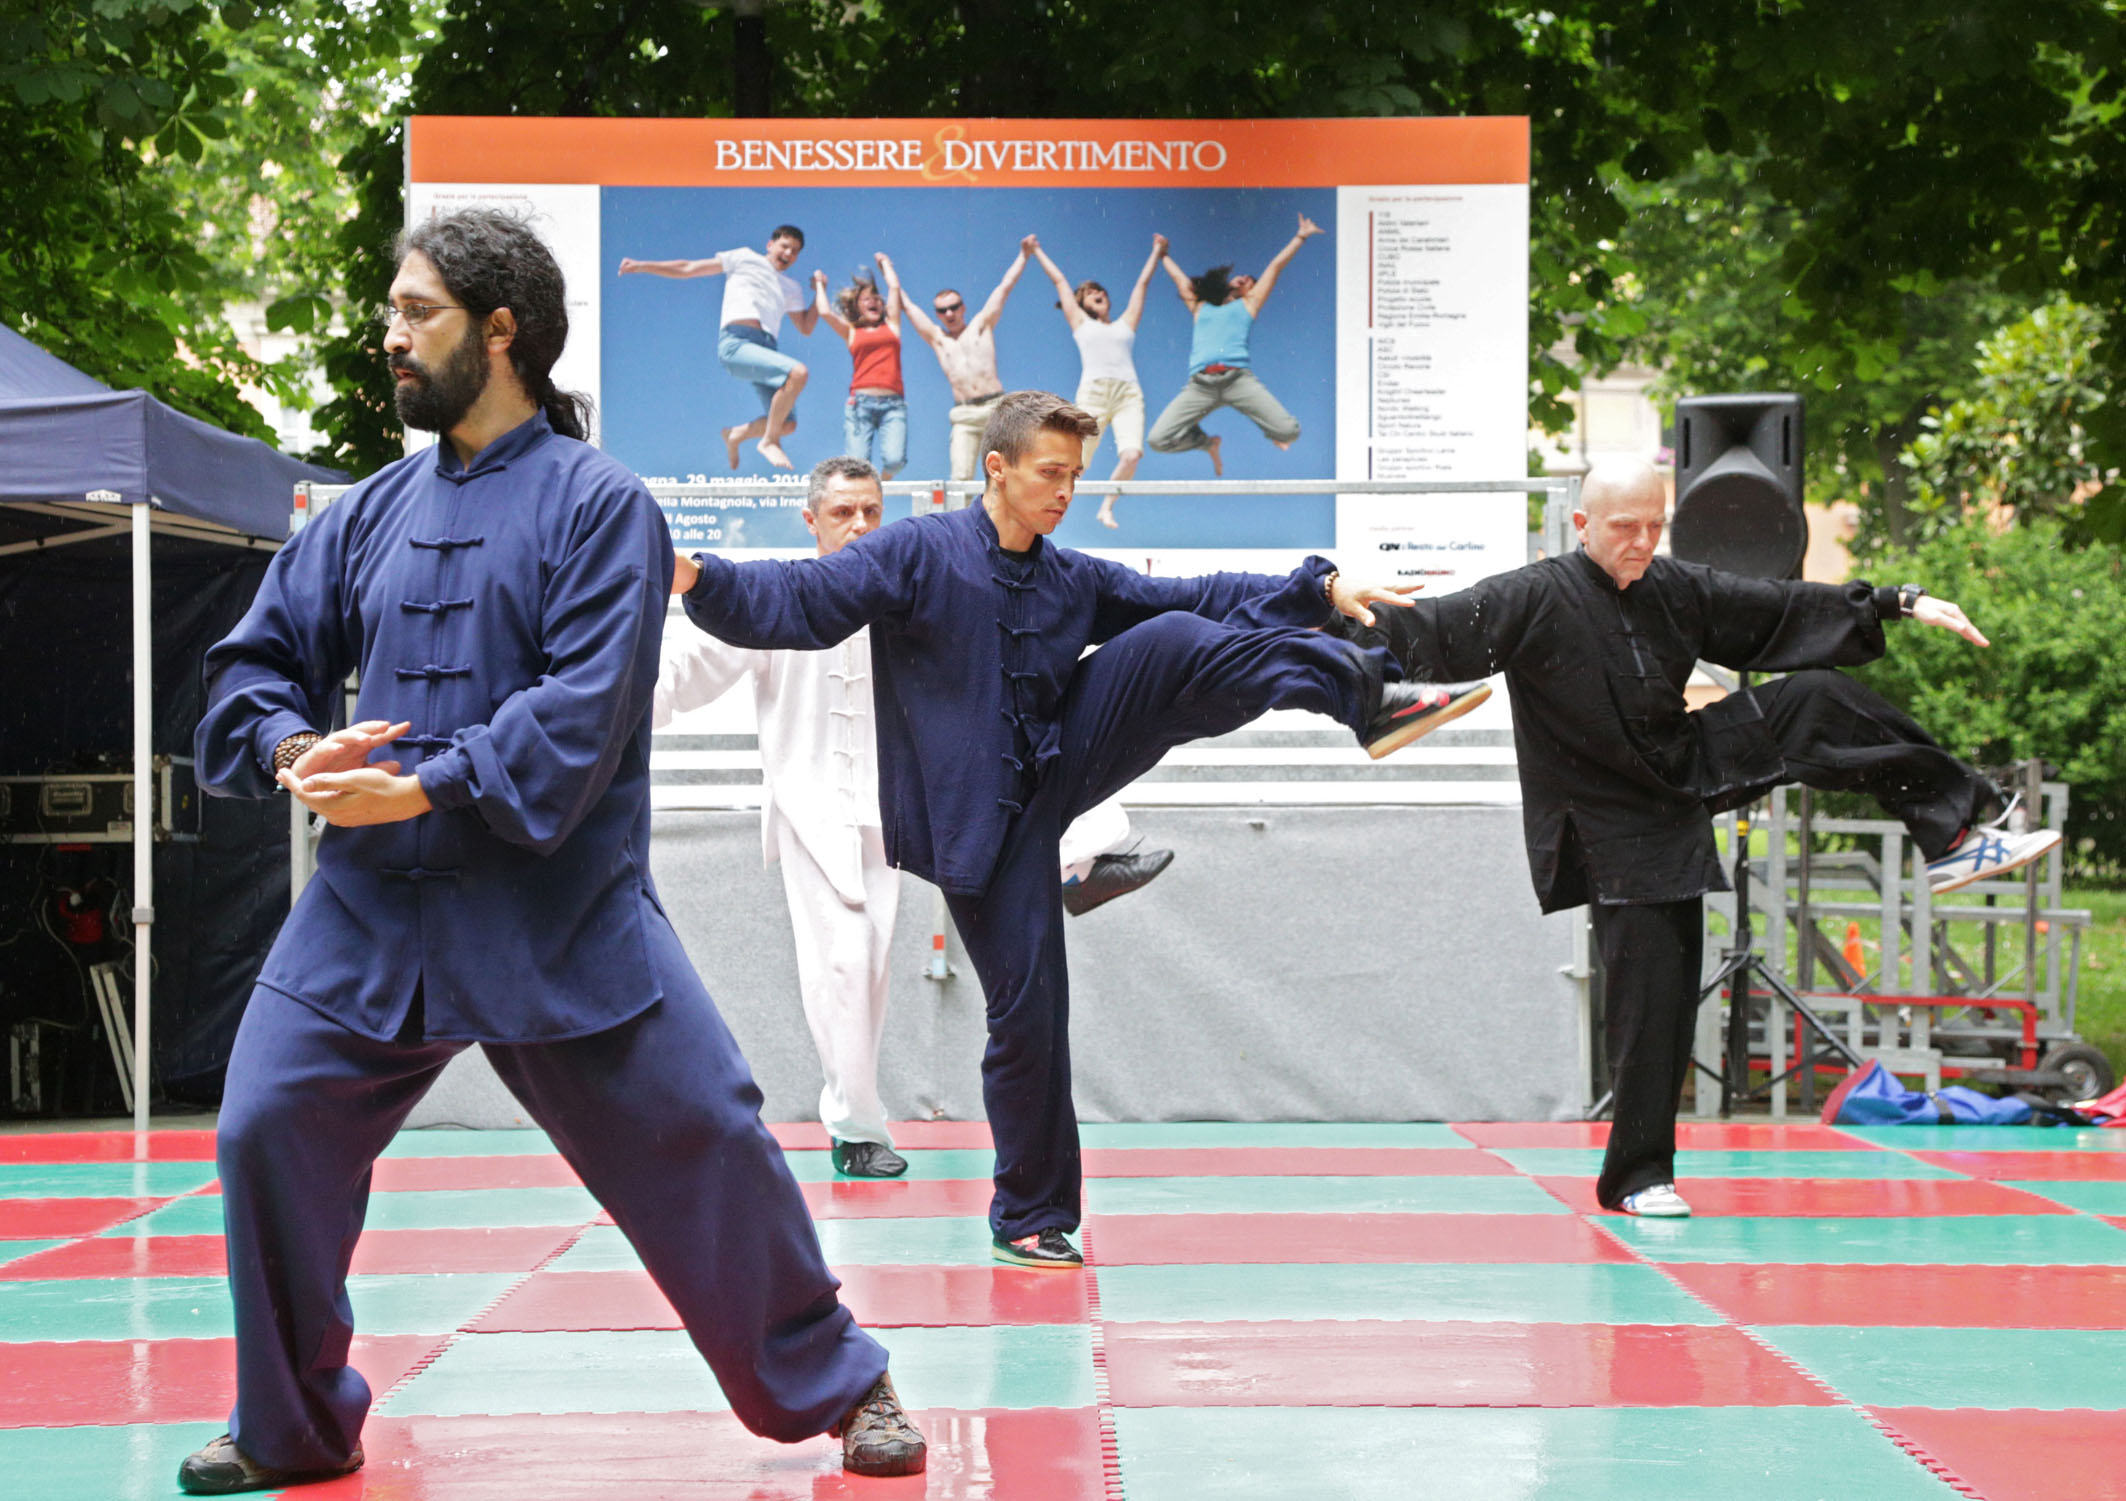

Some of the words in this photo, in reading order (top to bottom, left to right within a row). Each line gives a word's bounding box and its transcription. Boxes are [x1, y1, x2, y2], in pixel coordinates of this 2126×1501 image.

[714, 139, 924, 171] BENESSERE
[921, 125, 978, 181] &
[943, 139, 1228, 171] DIVERTIMENTO
[686, 473, 706, 487] 29
[772, 473, 811, 487] 2016
[680, 496, 757, 510] Montagnola,
[759, 496, 778, 508] via
[675, 512, 717, 527] Agosto
[683, 528, 705, 540] alle
[707, 529, 722, 540] 20
